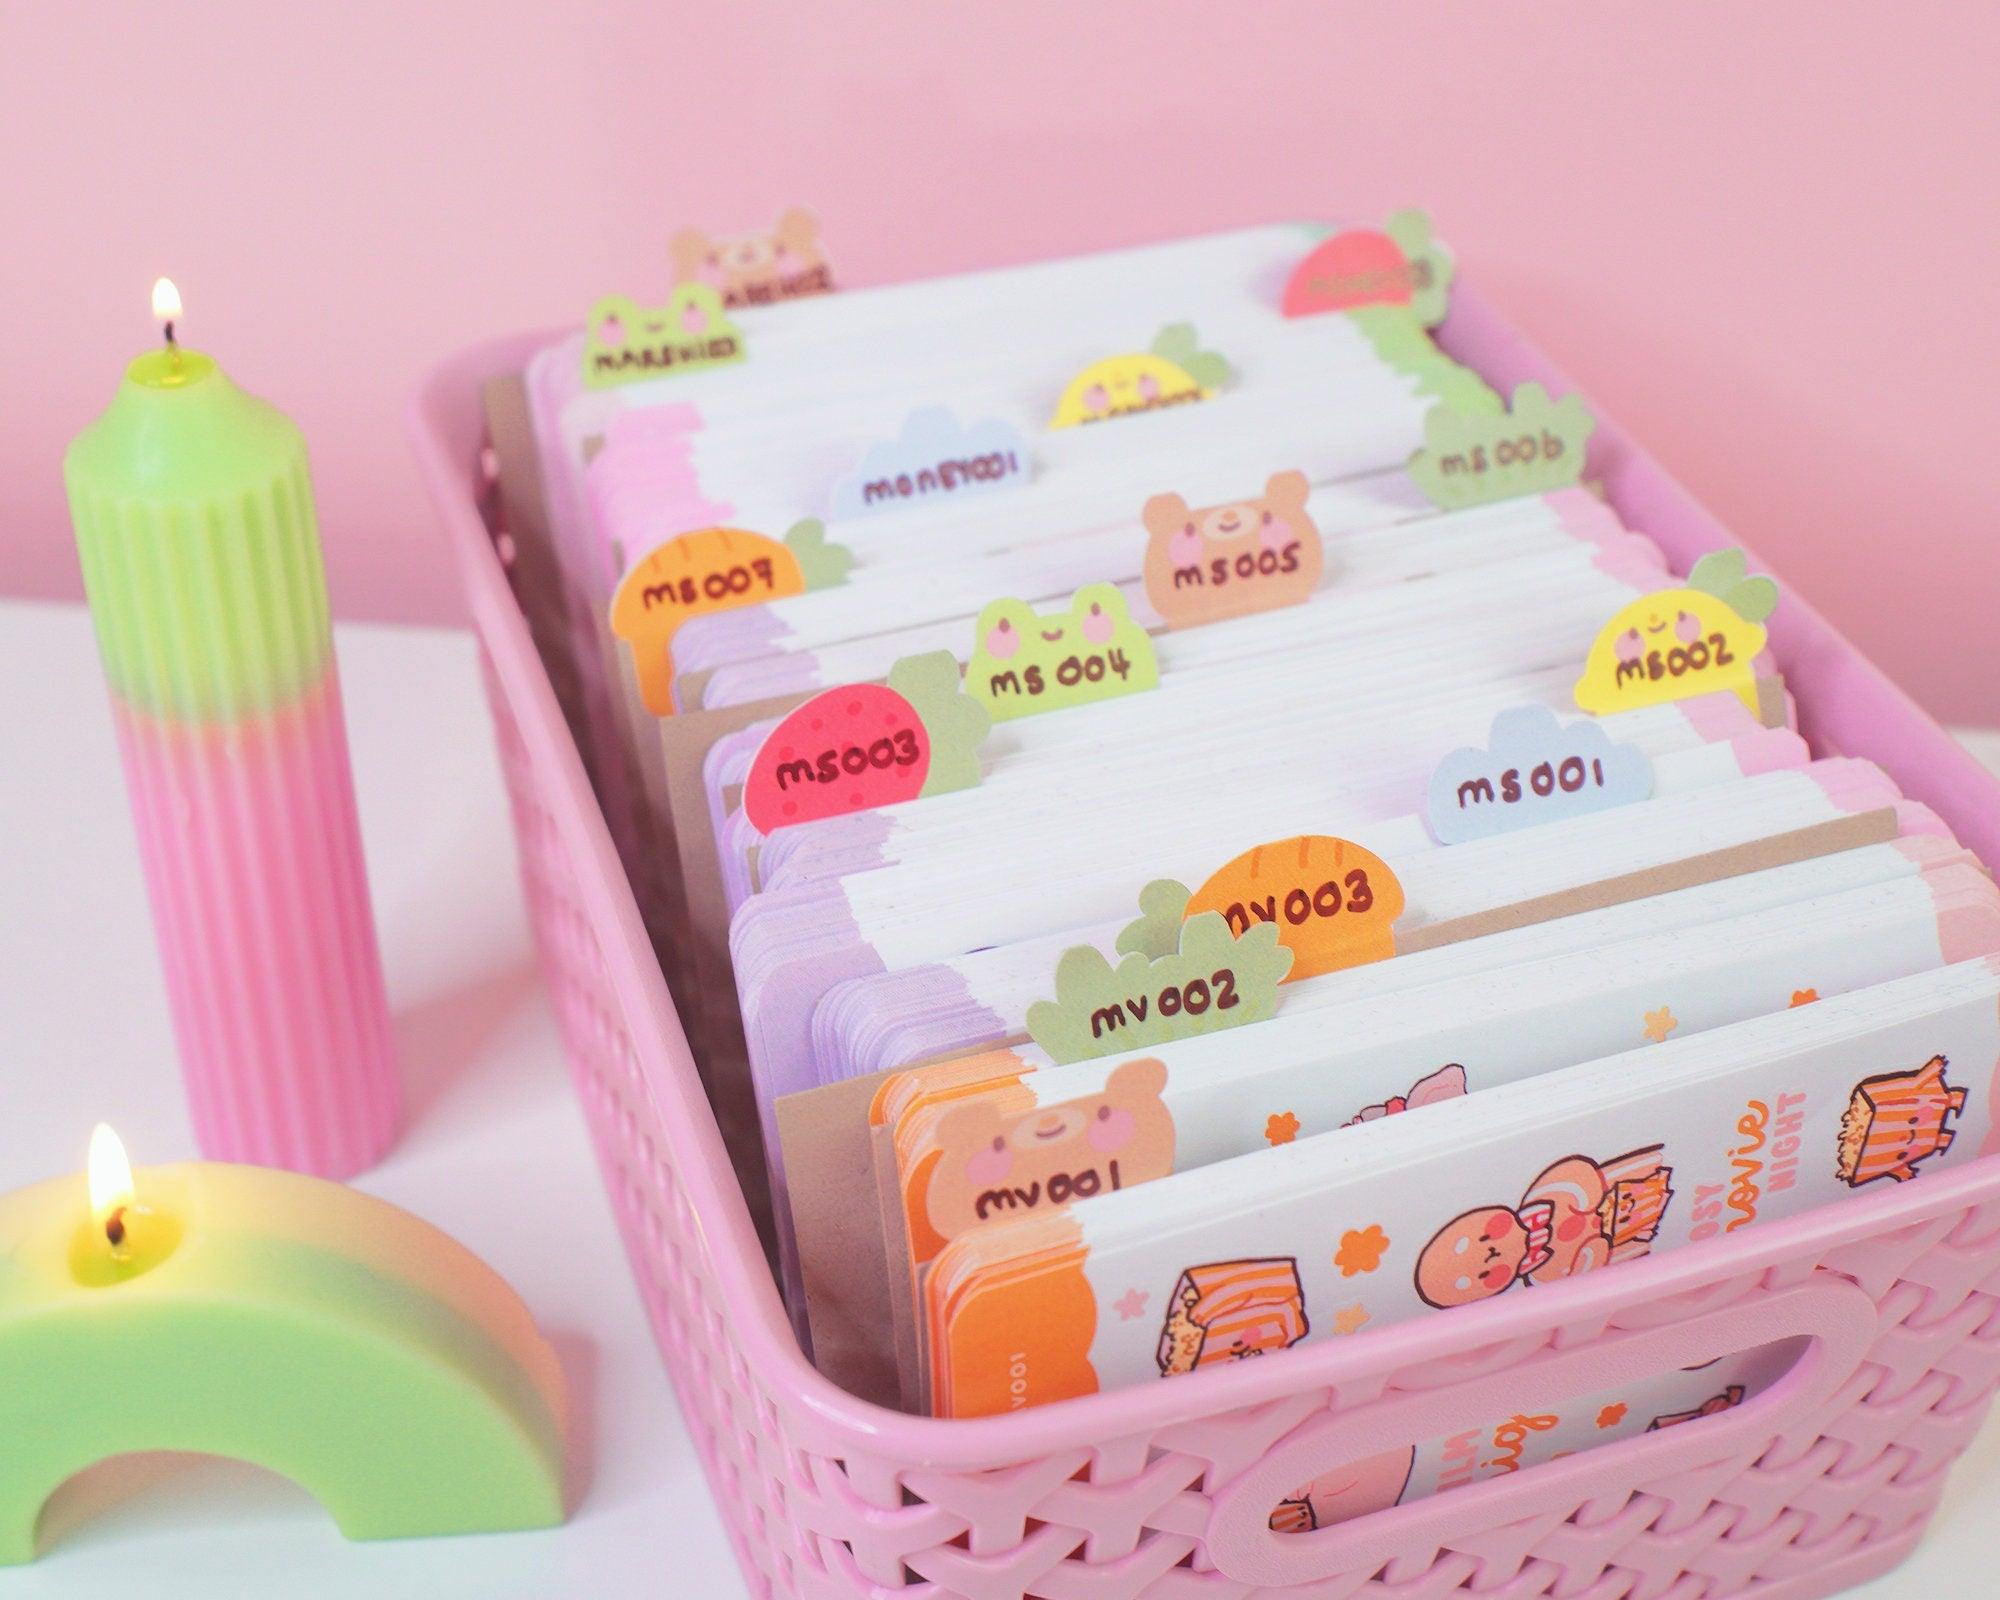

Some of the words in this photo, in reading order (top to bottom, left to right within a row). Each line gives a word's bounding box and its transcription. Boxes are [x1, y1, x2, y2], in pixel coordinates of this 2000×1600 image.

[1767, 1092, 1807, 1193] NIGHT
[1689, 1183, 1726, 1242] OSY
[1009, 1352, 1027, 1409] V001
[1436, 1428, 1482, 1494] ILM
